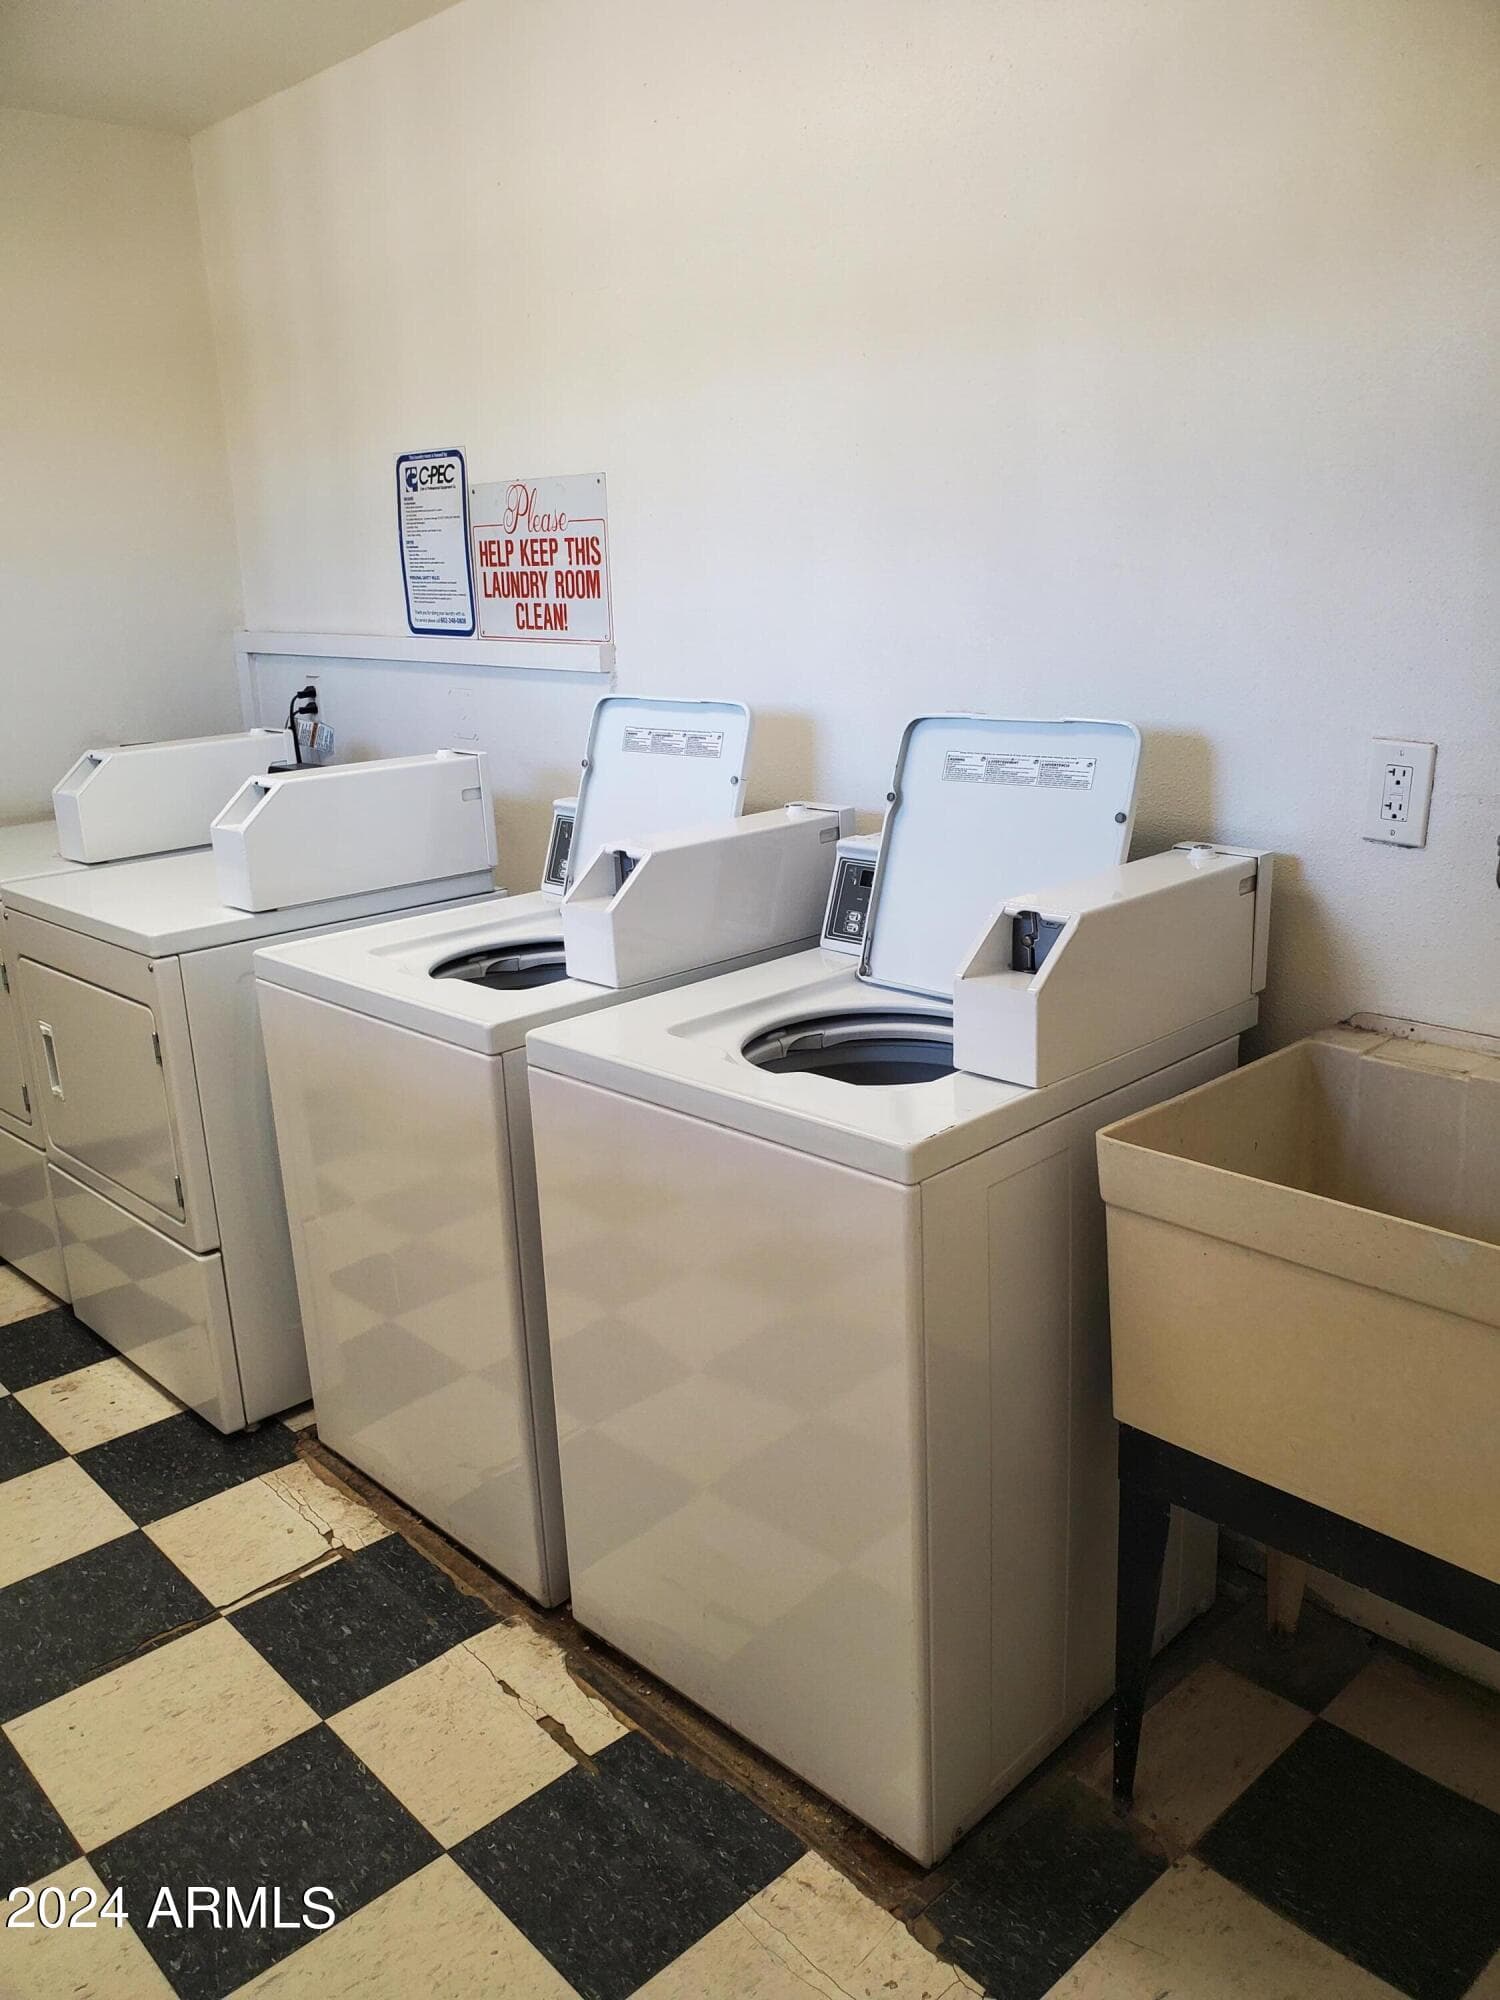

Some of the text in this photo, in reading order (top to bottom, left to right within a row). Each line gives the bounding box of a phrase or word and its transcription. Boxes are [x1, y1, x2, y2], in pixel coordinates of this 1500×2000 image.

[419, 463, 455, 485] C-PEC
[503, 483, 569, 534] Please
[479, 536, 601, 567] HELP KEEP THIS
[483, 570, 548, 598] LAUNDRY
[555, 570, 601, 599] ROOM
[515, 602, 568, 631] CLEAN!
